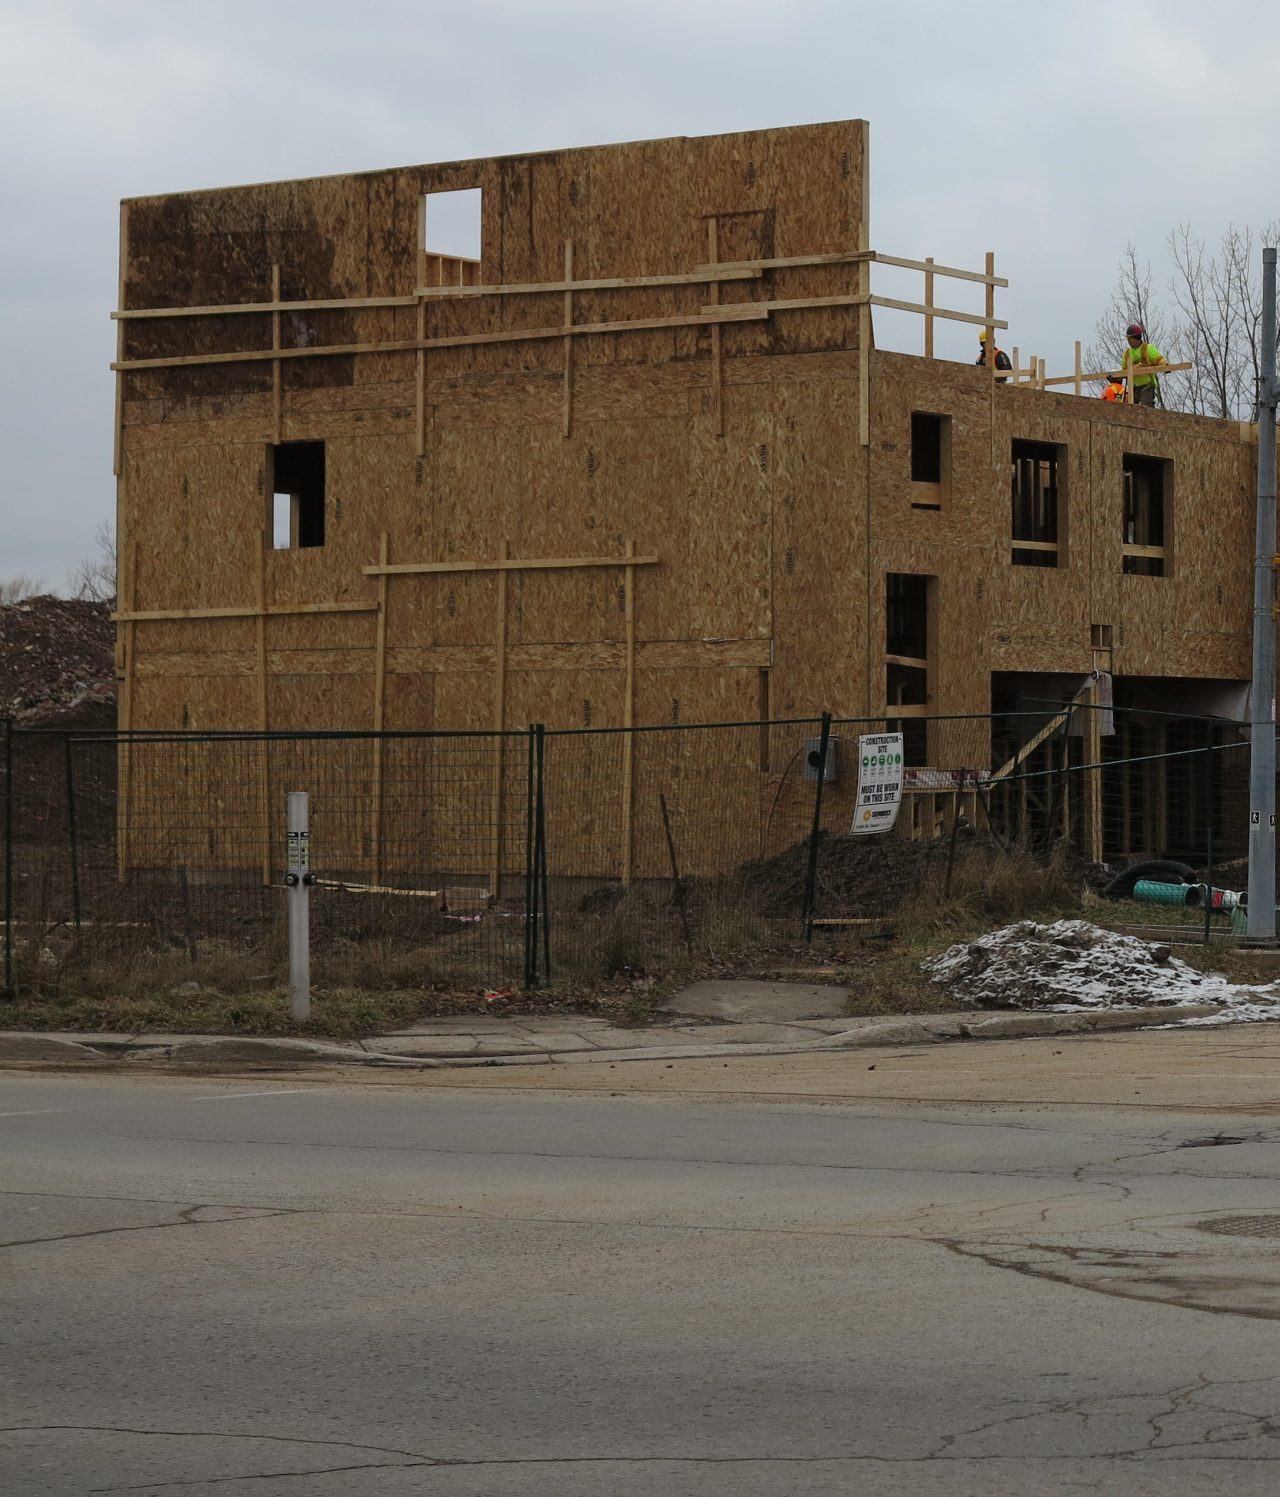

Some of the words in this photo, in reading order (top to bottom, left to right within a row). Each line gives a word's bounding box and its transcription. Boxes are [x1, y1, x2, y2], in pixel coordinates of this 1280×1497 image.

[865, 736, 899, 746] CONSTRUCTION
[877, 745, 888, 754] SITE
[861, 784, 876, 794] MUST
[876, 784, 884, 793] BE
[884, 783, 899, 792] WORN
[863, 794, 871, 803] ON
[871, 793, 883, 803] THIS
[884, 792, 895, 801] SITE
